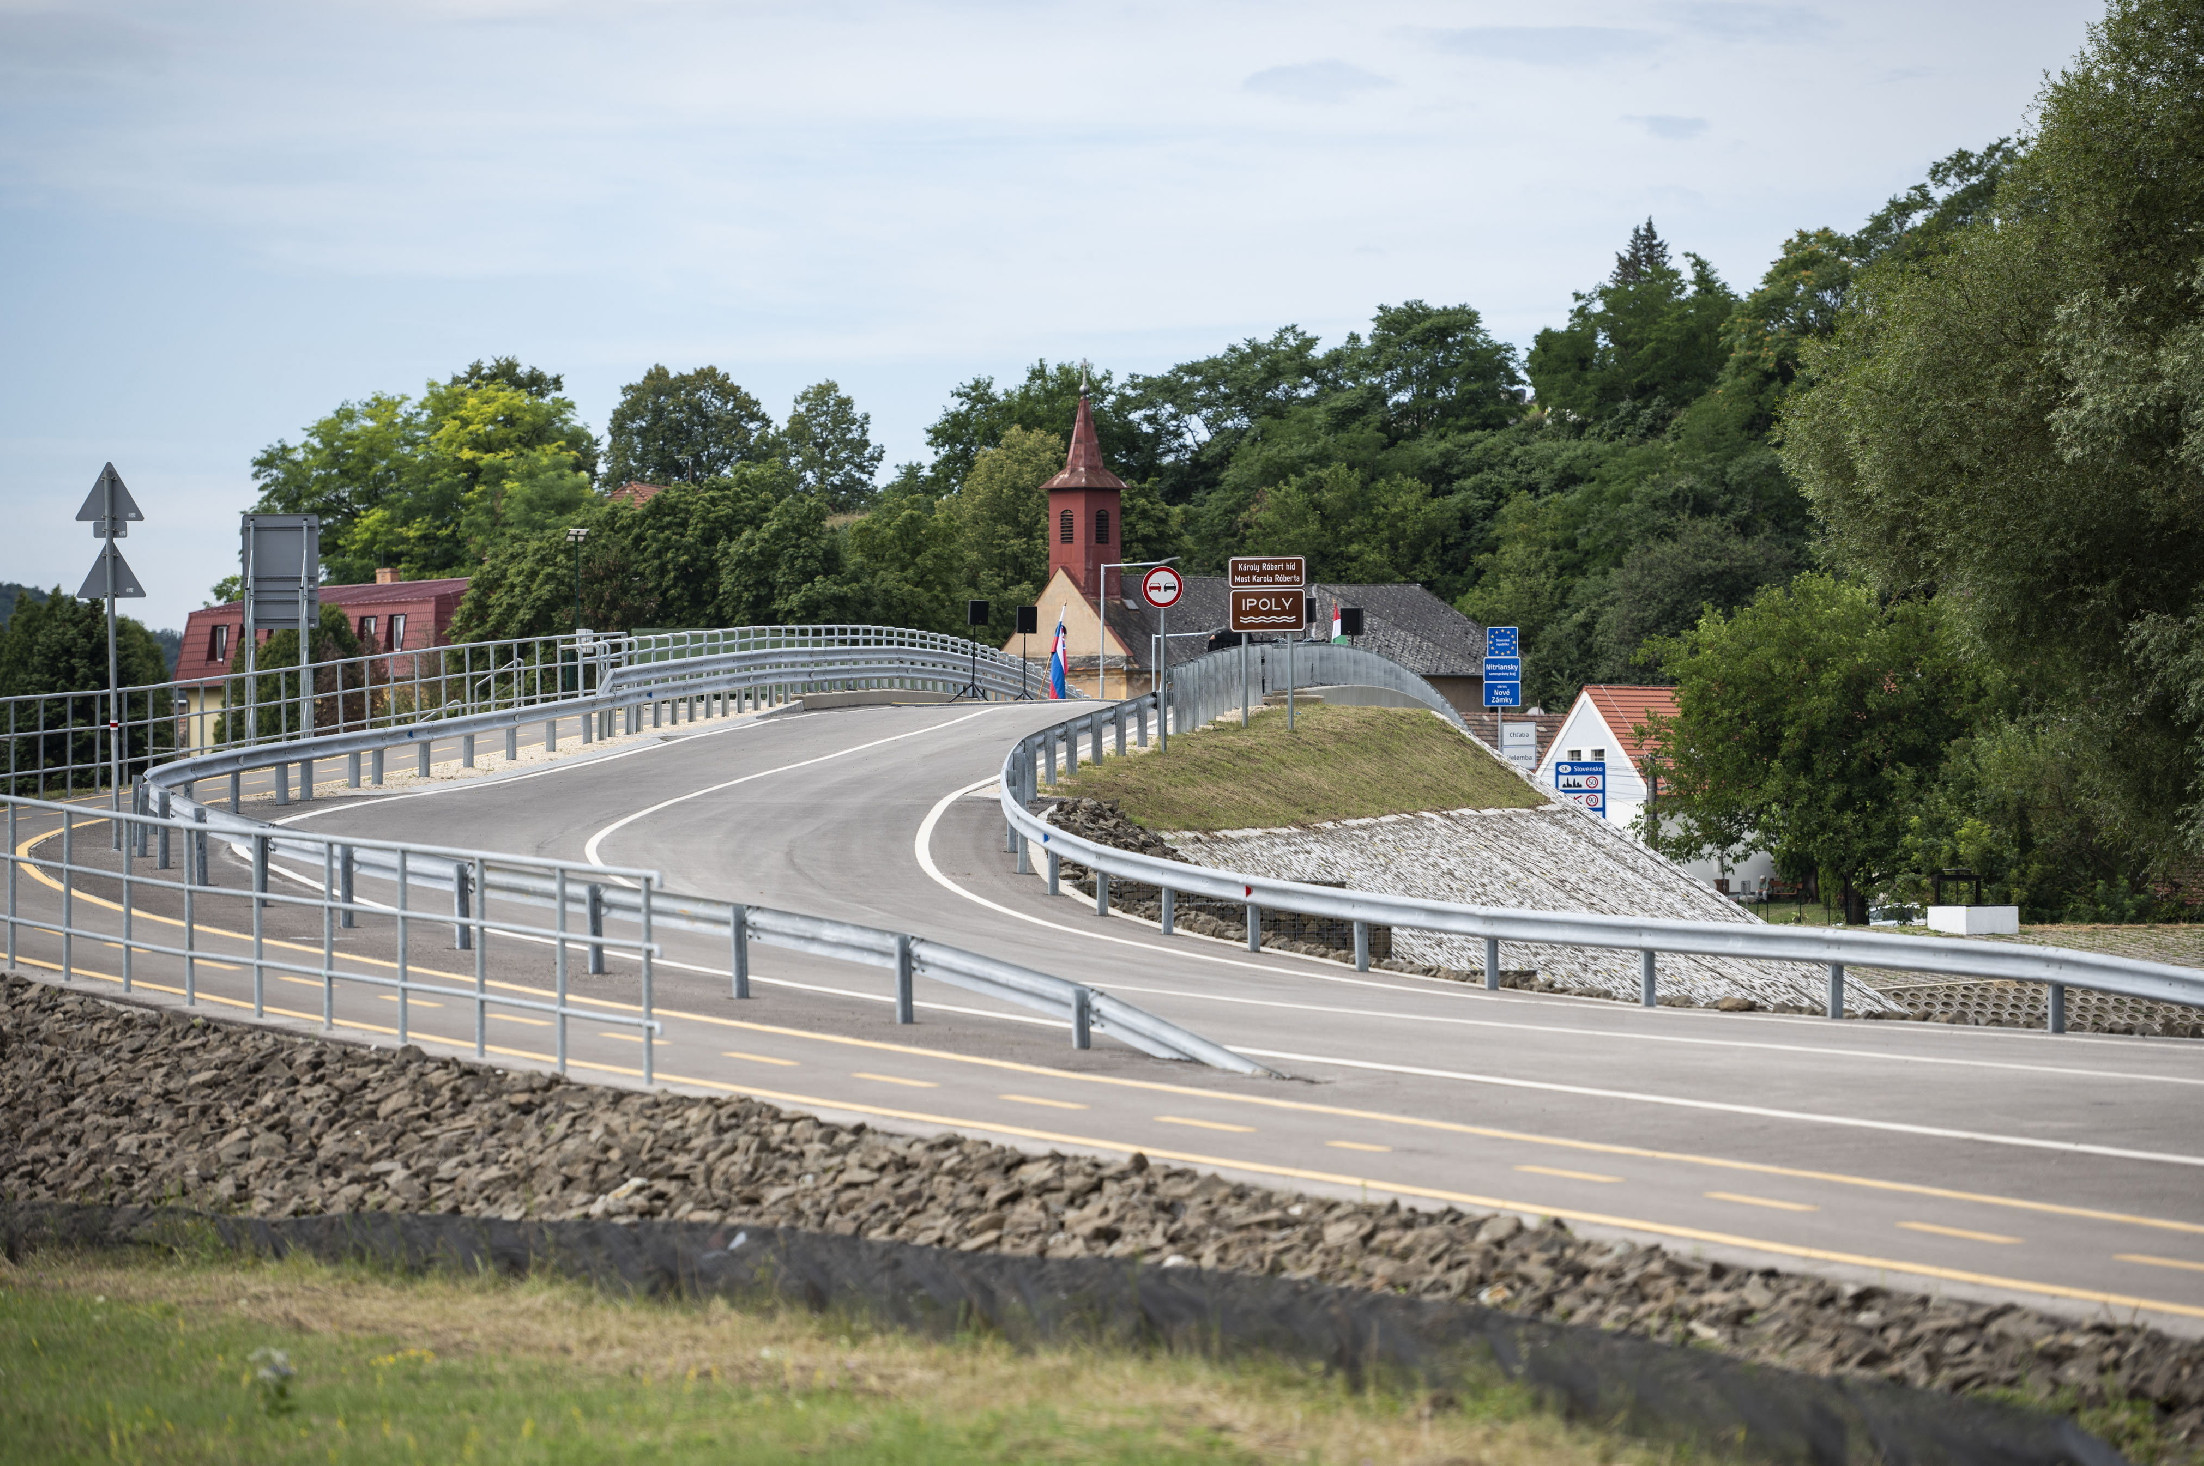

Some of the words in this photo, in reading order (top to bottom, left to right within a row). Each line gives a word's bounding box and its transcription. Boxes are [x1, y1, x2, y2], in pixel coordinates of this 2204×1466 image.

[1238, 563, 1260, 572] Károly
[1262, 562, 1284, 570] Róbert
[1286, 562, 1296, 570] híd
[1252, 574, 1272, 582] Karola
[1275, 574, 1300, 582] Róberta
[1242, 598, 1293, 610] IPOLY
